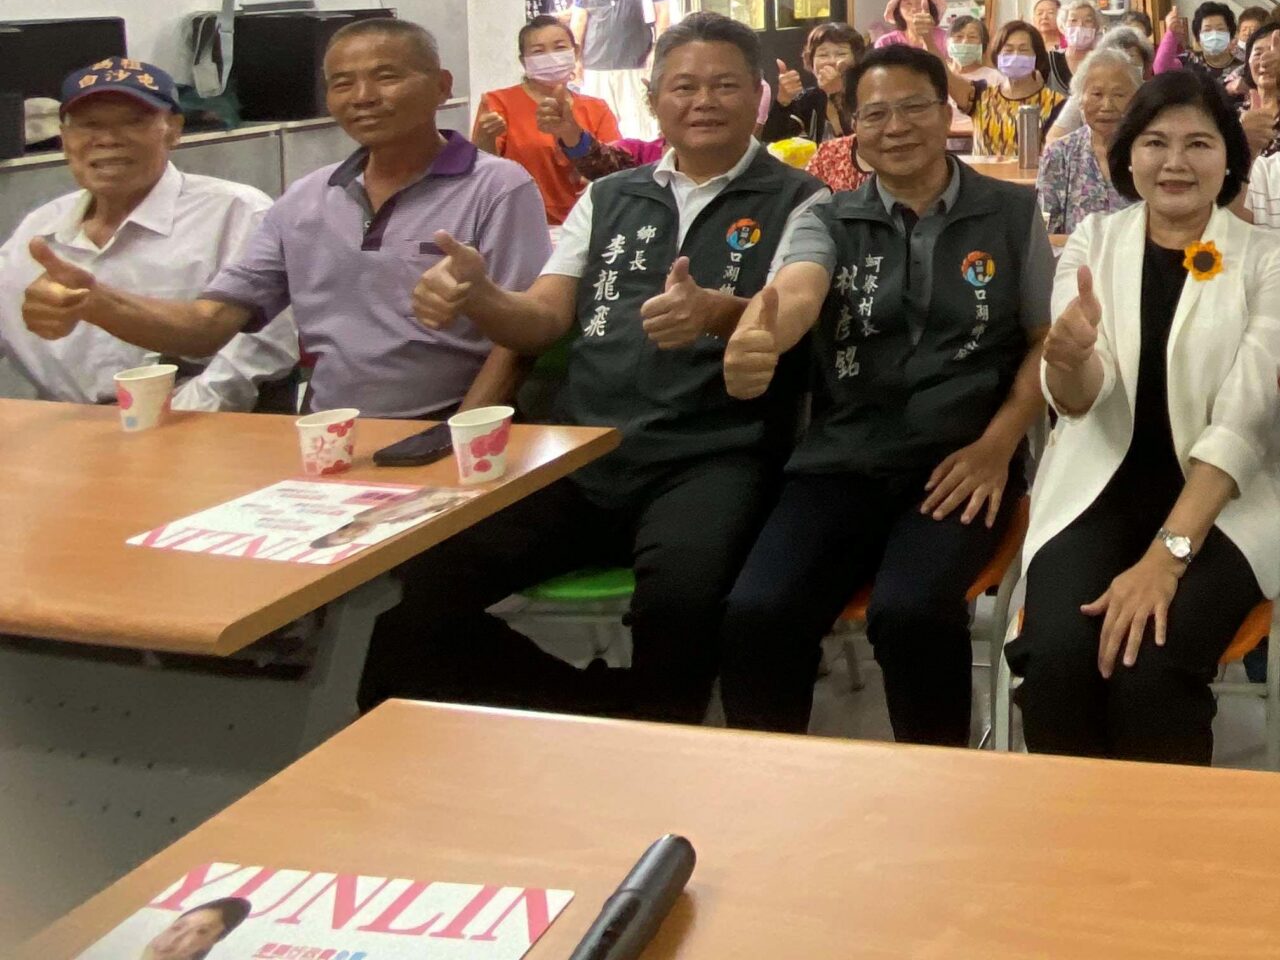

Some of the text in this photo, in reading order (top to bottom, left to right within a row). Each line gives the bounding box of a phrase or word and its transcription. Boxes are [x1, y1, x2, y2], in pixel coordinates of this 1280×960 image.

[78, 69, 160, 90] 白沙屯
[629, 225, 657, 271] 鄉長
[584, 233, 627, 337] 李龍飛
[148, 862, 552, 943] YUNLIN
